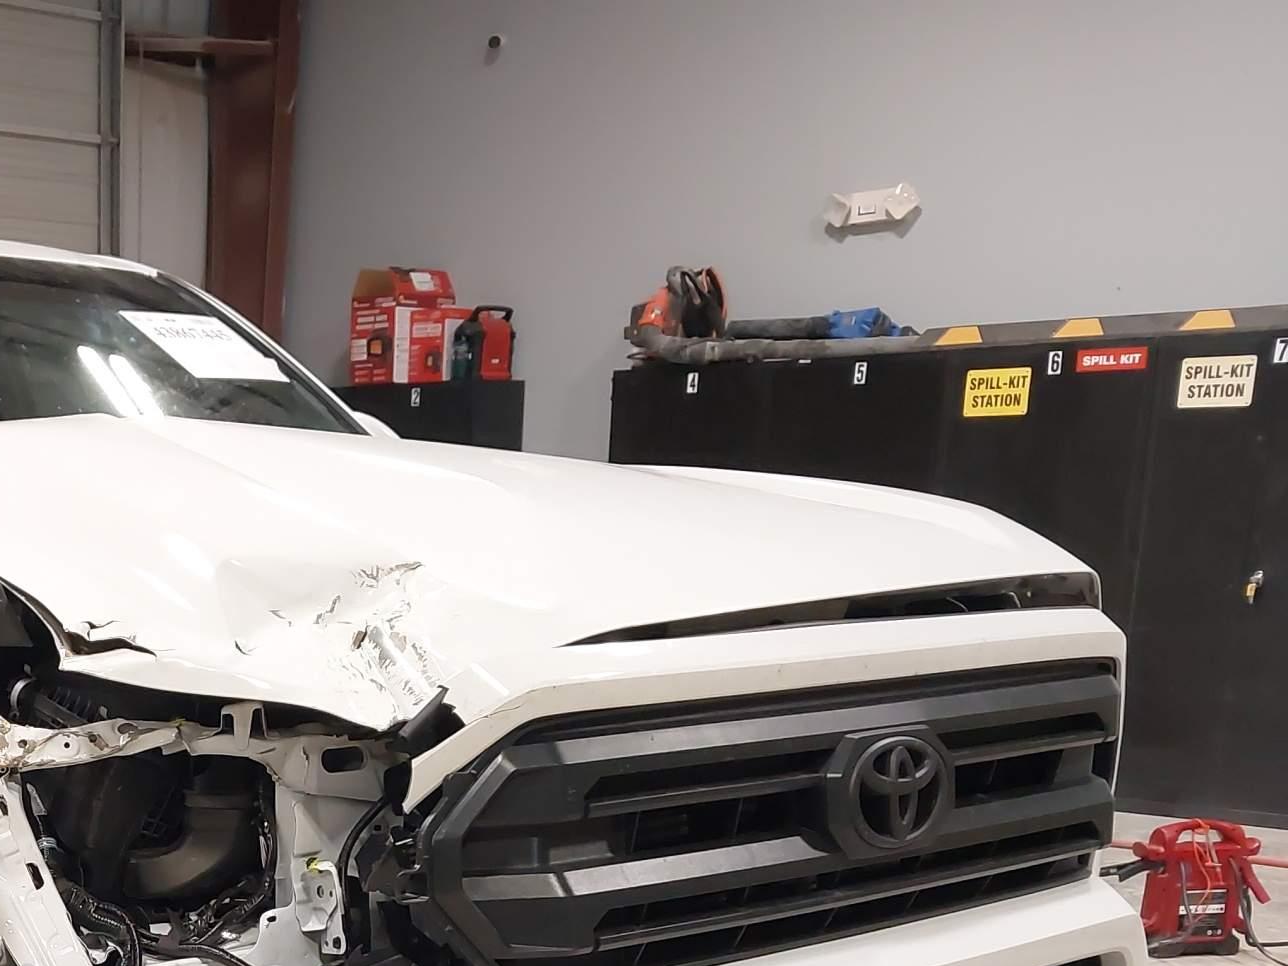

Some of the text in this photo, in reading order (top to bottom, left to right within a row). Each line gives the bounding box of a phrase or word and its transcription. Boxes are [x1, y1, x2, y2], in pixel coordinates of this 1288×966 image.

[1050, 353, 1061, 373] 6
[1082, 353, 1142, 367] SPILL KIT
[855, 363, 866, 382] 5
[1184, 363, 1254, 380] SPILL-KIT
[688, 373, 697, 392] 4
[969, 375, 1029, 391] SPILL-KIT
[1187, 383, 1246, 399] STATION
[412, 388, 420, 406] 2
[971, 393, 1022, 408] STATION
